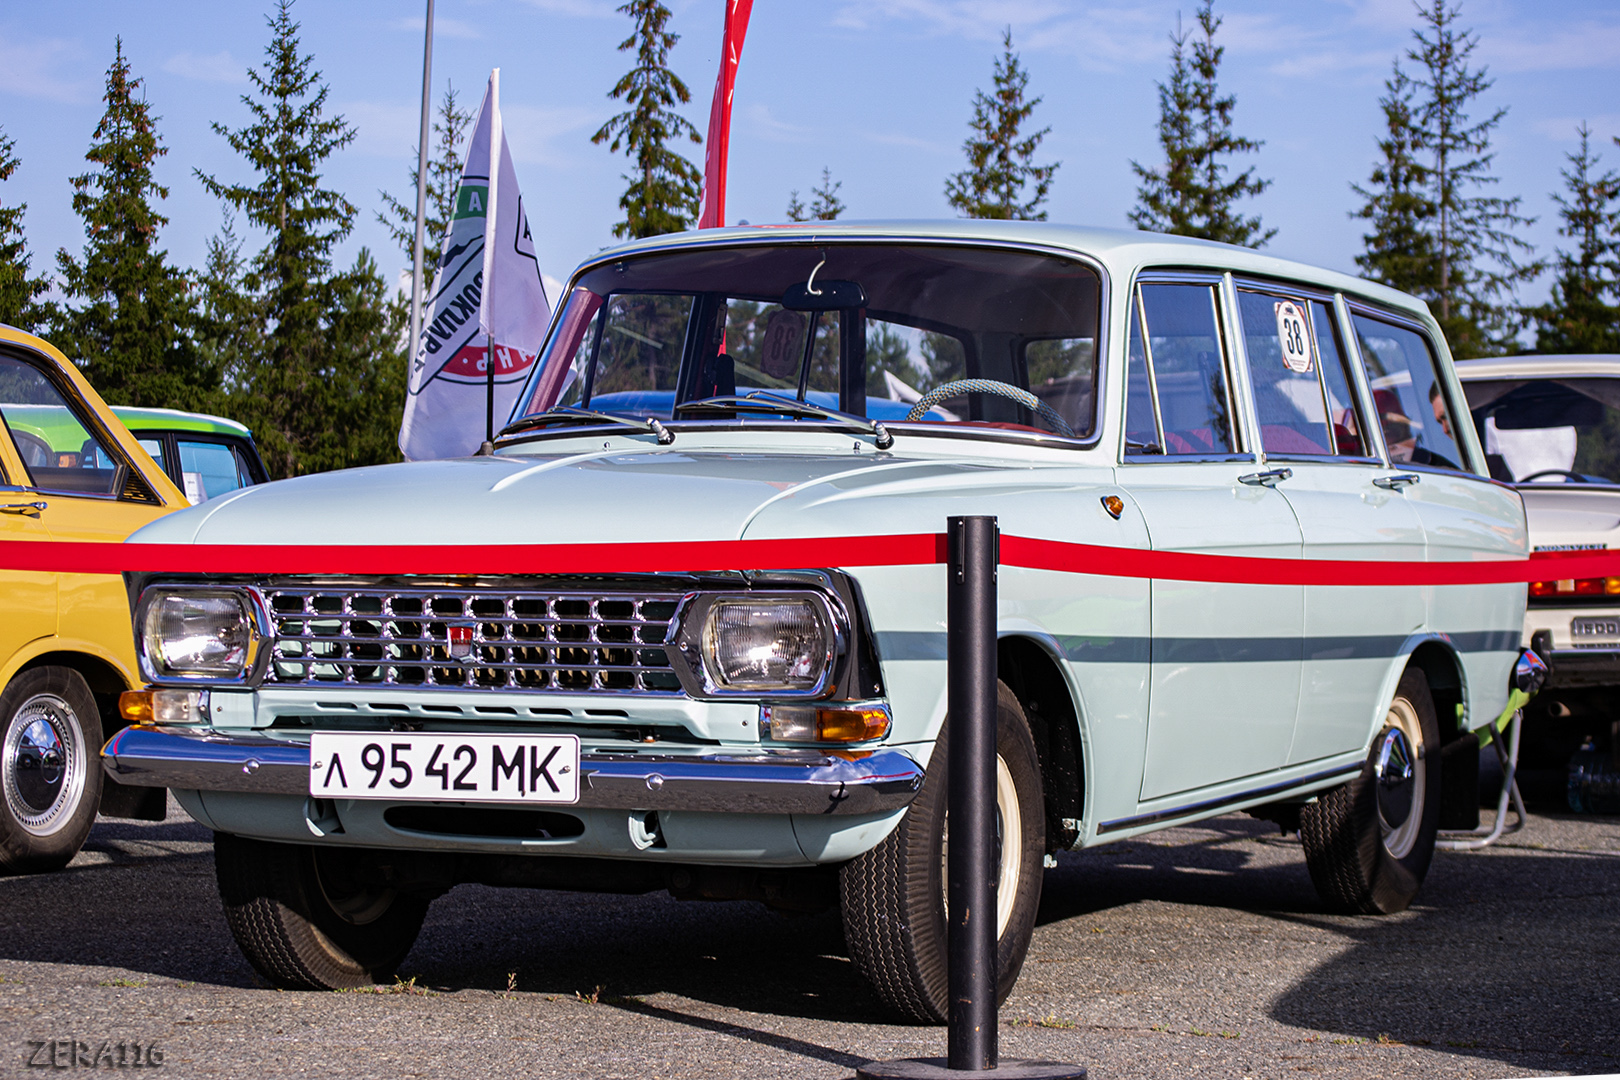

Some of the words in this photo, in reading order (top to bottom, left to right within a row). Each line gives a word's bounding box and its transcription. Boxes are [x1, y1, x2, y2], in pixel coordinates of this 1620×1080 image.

[1283, 318, 1304, 356] 38
[361, 743, 413, 789] 95
[425, 744, 477, 791] 42
[492, 745, 562, 792] МК
